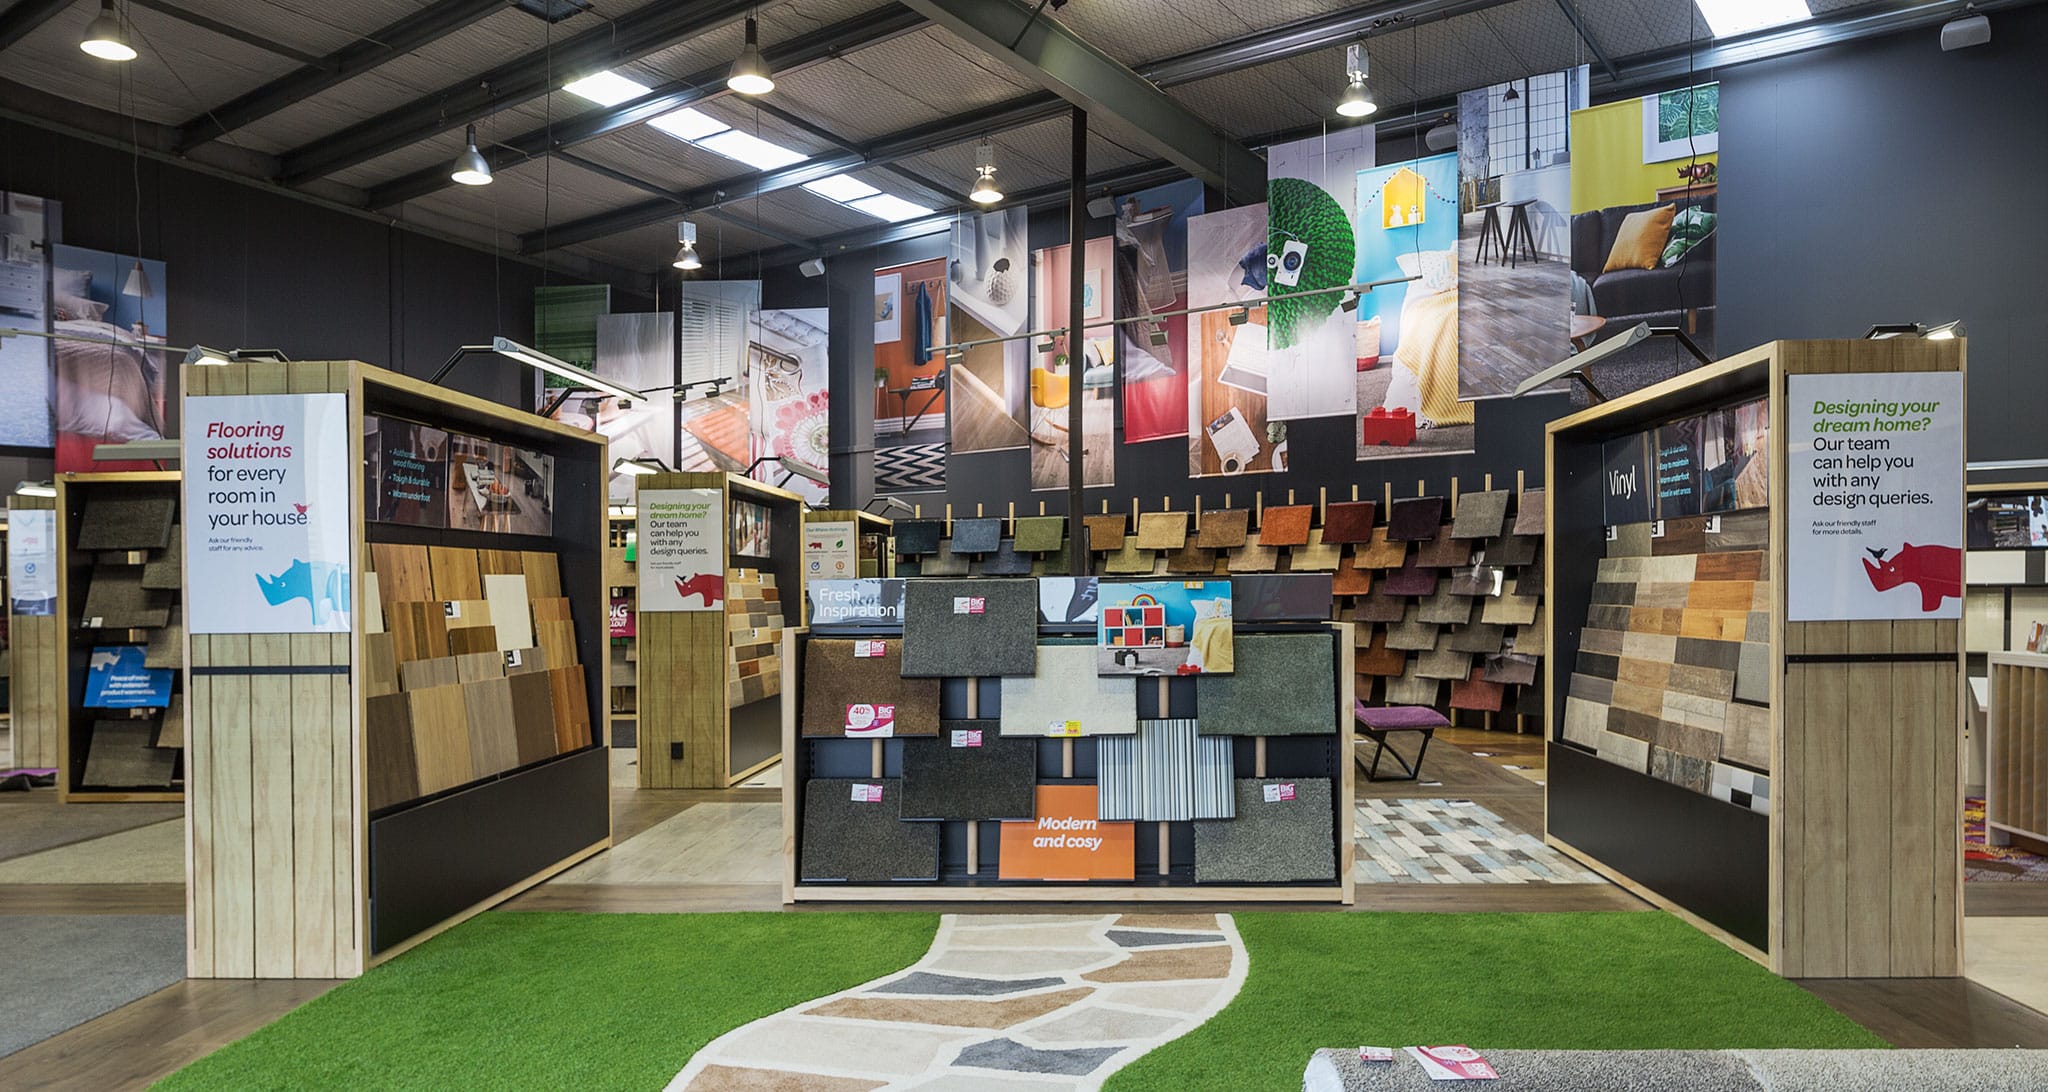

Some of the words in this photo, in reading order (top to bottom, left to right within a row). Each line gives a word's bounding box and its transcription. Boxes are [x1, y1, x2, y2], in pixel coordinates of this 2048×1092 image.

[1813, 399, 1898, 418] Designing
[1899, 401, 1940, 417] your
[207, 420, 285, 441] Flooring
[1813, 418, 1870, 433] dream
[1873, 417, 1932, 432] home?
[207, 442, 292, 460] solutions
[1813, 437, 1844, 451] Our
[1847, 437, 1890, 451] team
[1813, 457, 1843, 469] can
[1846, 454, 1881, 472] help
[1884, 456, 1914, 472] you
[207, 465, 234, 481] for
[236, 468, 287, 485] every
[1609, 464, 1637, 500] Vinyl
[1813, 472, 1847, 487] with
[1850, 475, 1880, 490] any
[208, 491, 256, 504] room
[260, 486, 276, 503] in
[1813, 490, 1866, 509] design
[1869, 489, 1933, 508] queries.
[650, 502, 691, 512] Designing
[691, 502, 712, 511] your
[650, 511, 678, 519] dream
[678, 511, 707, 519] home?
[208, 513, 249, 530] your
[650, 520, 665, 528] Our
[666, 520, 688, 528] team
[1836, 519, 1861, 528] friendly
[1861, 519, 1877, 527] staff
[650, 530, 665, 538] can
[665, 529, 684, 539] help
[684, 530, 699, 539] you
[1840, 527, 1863, 535] details.
[650, 538, 667, 546] with
[668, 539, 683, 547] any
[650, 547, 676, 557] design
[677, 546, 709, 556] queries.
[819, 587, 861, 602] Fresh
[819, 603, 896, 621] Inspiration
[1037, 816, 1097, 831] Modern
[1032, 833, 1066, 848] and
[1066, 836, 1103, 852] cosy
